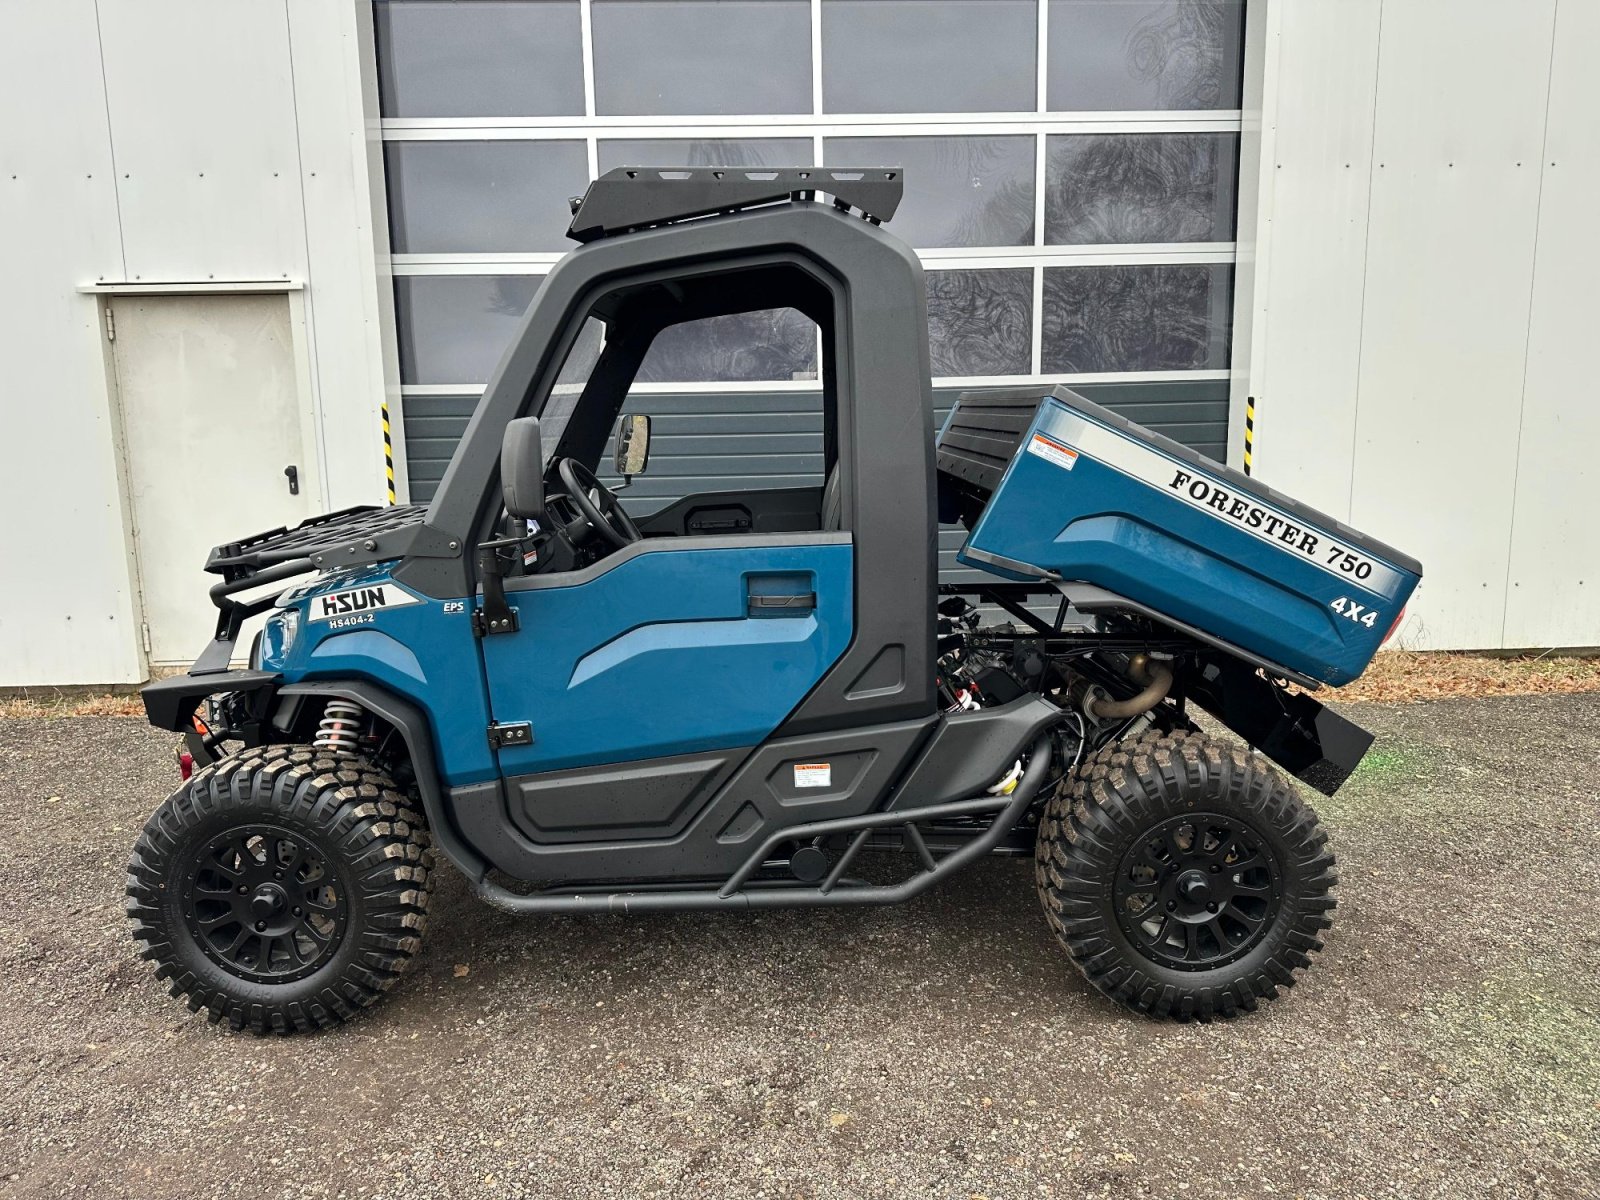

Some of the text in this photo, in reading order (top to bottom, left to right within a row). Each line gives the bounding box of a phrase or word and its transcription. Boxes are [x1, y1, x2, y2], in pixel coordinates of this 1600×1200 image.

[1169, 470, 1372, 580] FORESTER 750
[443, 601, 464, 612] EPS
[1330, 595, 1379, 628] 4X4
[329, 614, 375, 629] HS404-2
